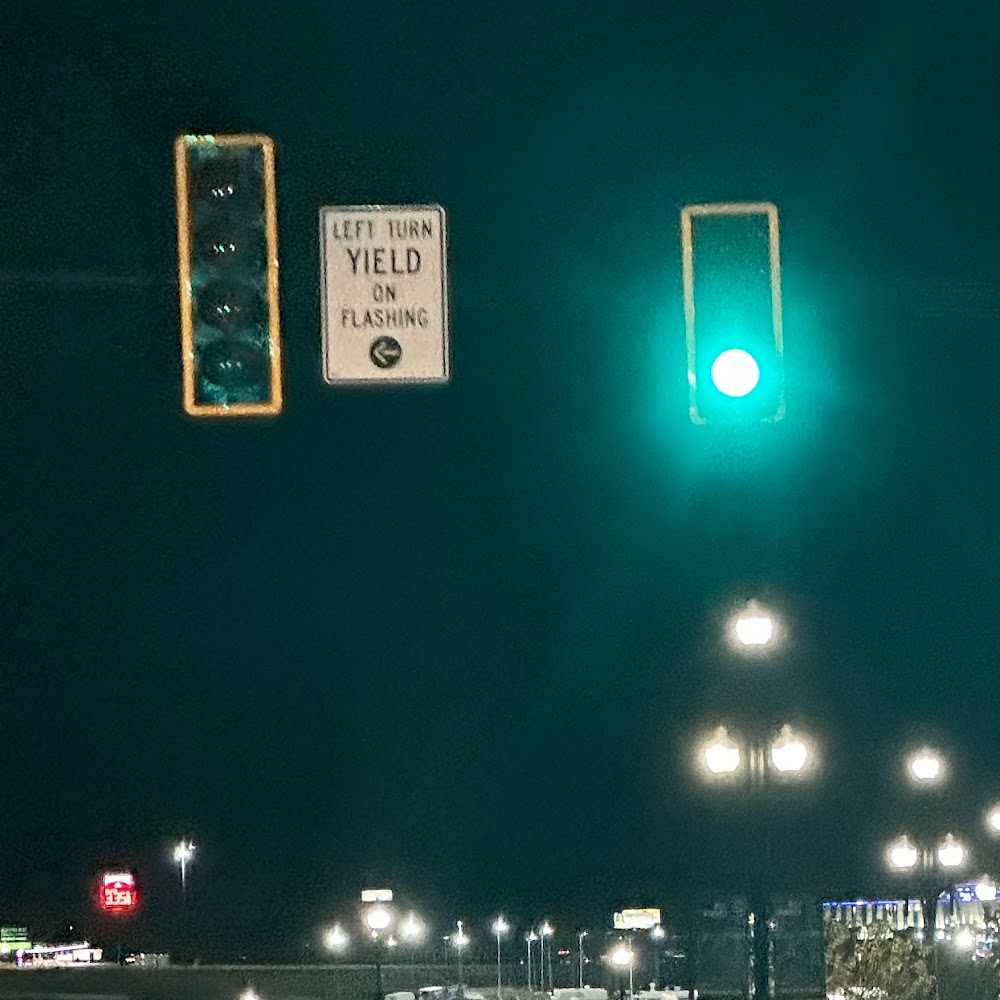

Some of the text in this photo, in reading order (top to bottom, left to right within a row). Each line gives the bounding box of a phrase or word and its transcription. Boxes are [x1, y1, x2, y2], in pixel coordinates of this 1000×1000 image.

[332, 219, 433, 240] LEFT TURN
[347, 248, 422, 275] YIELD
[372, 283, 396, 302] ON
[341, 308, 429, 329] FLASHING
